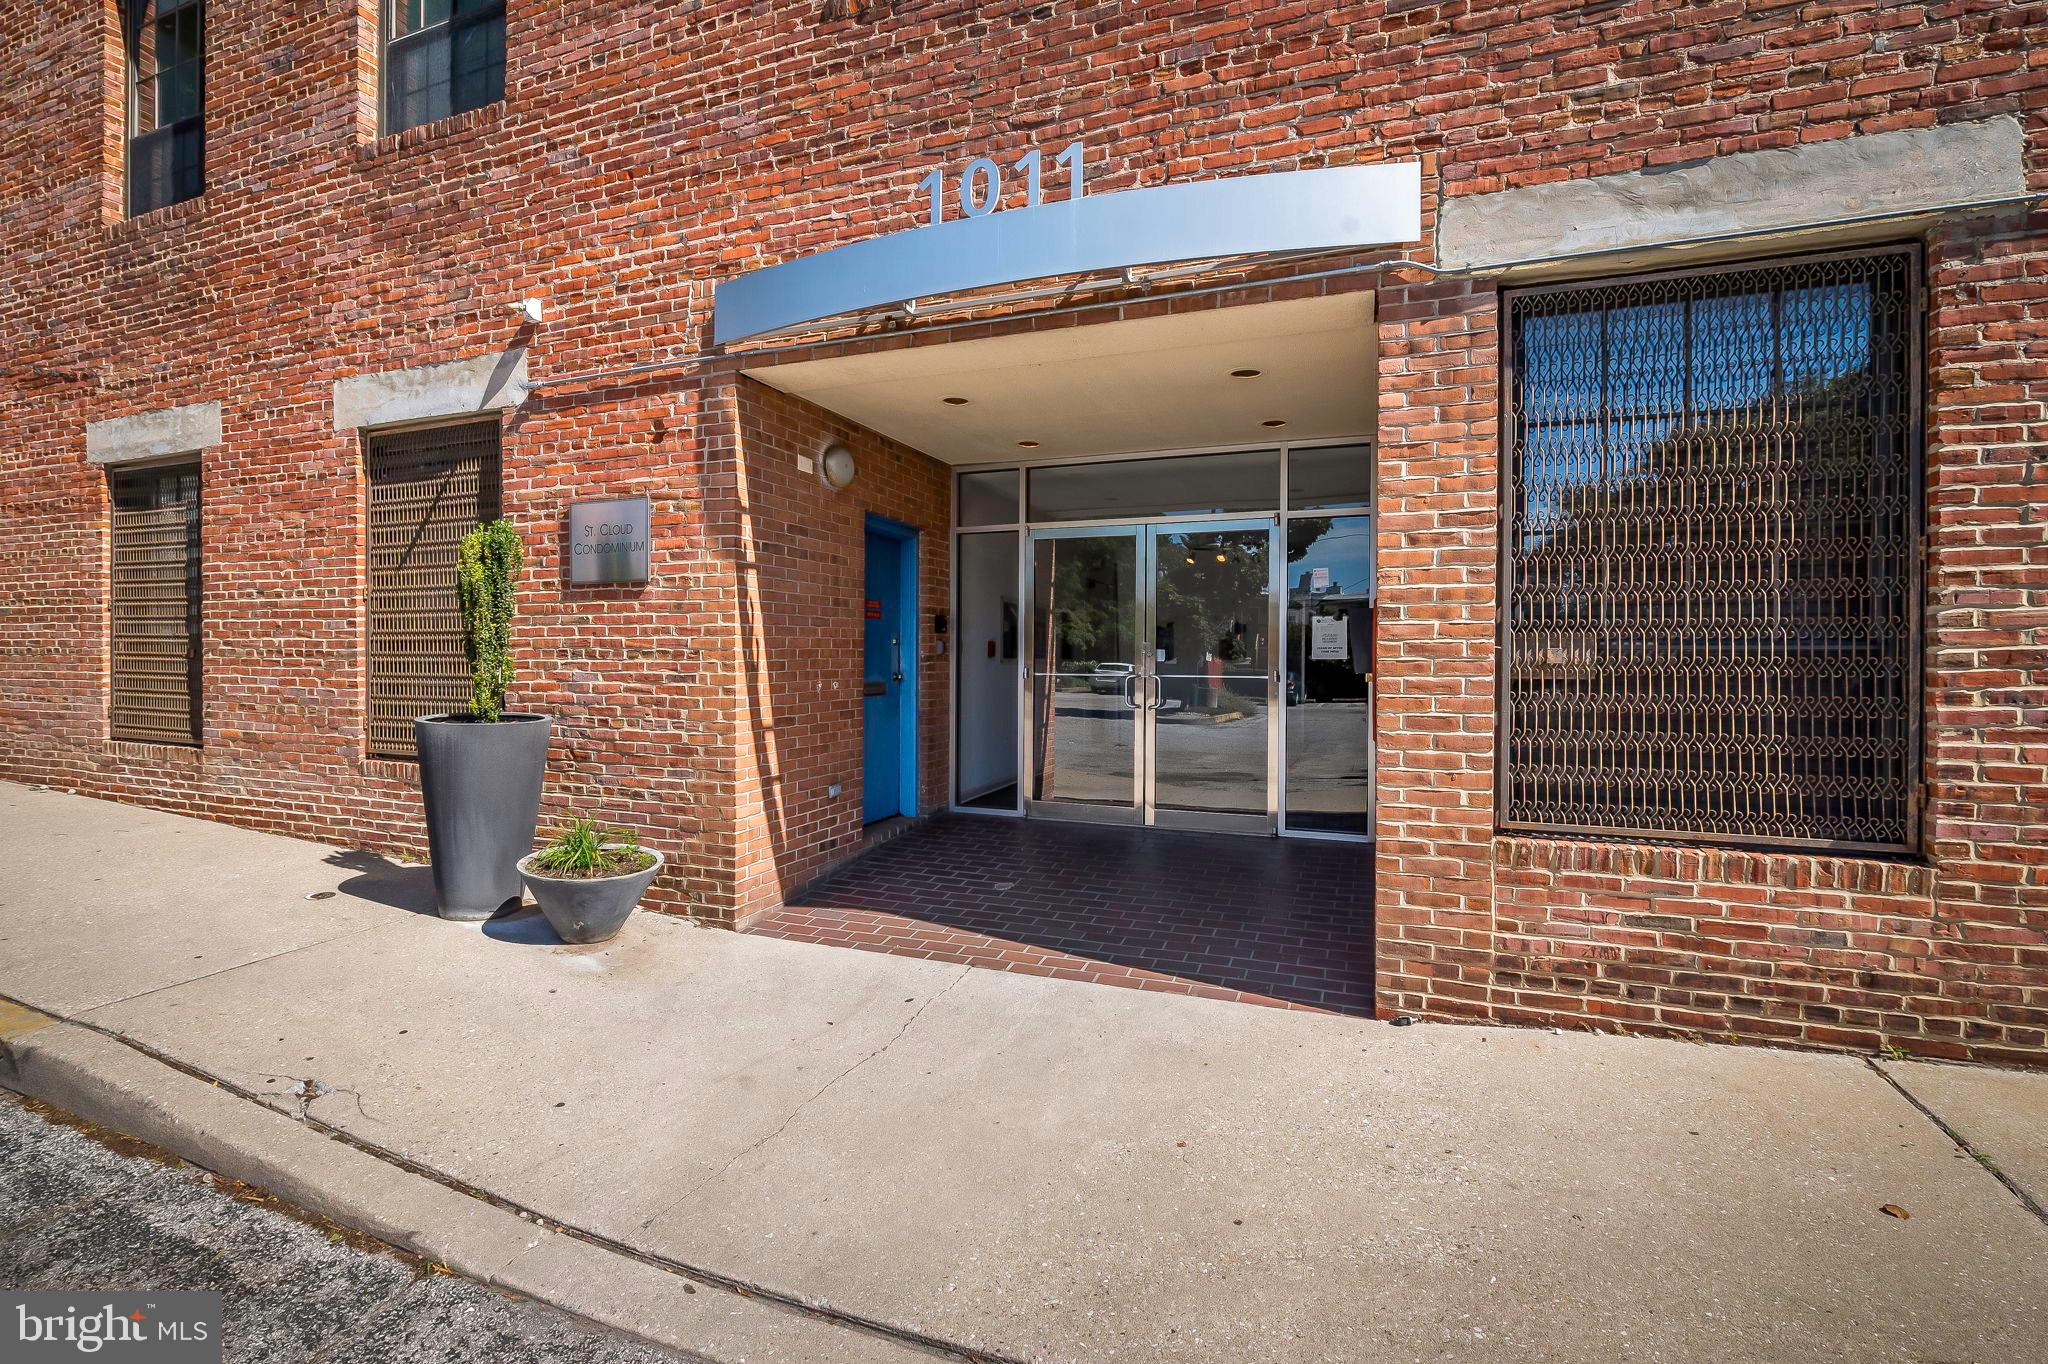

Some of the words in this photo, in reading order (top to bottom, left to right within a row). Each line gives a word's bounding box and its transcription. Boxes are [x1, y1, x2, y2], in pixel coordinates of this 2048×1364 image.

[918, 142, 1083, 225] 1011
[600, 524, 633, 536] CLOUD
[574, 541, 645, 555] CONDOMINIUM
